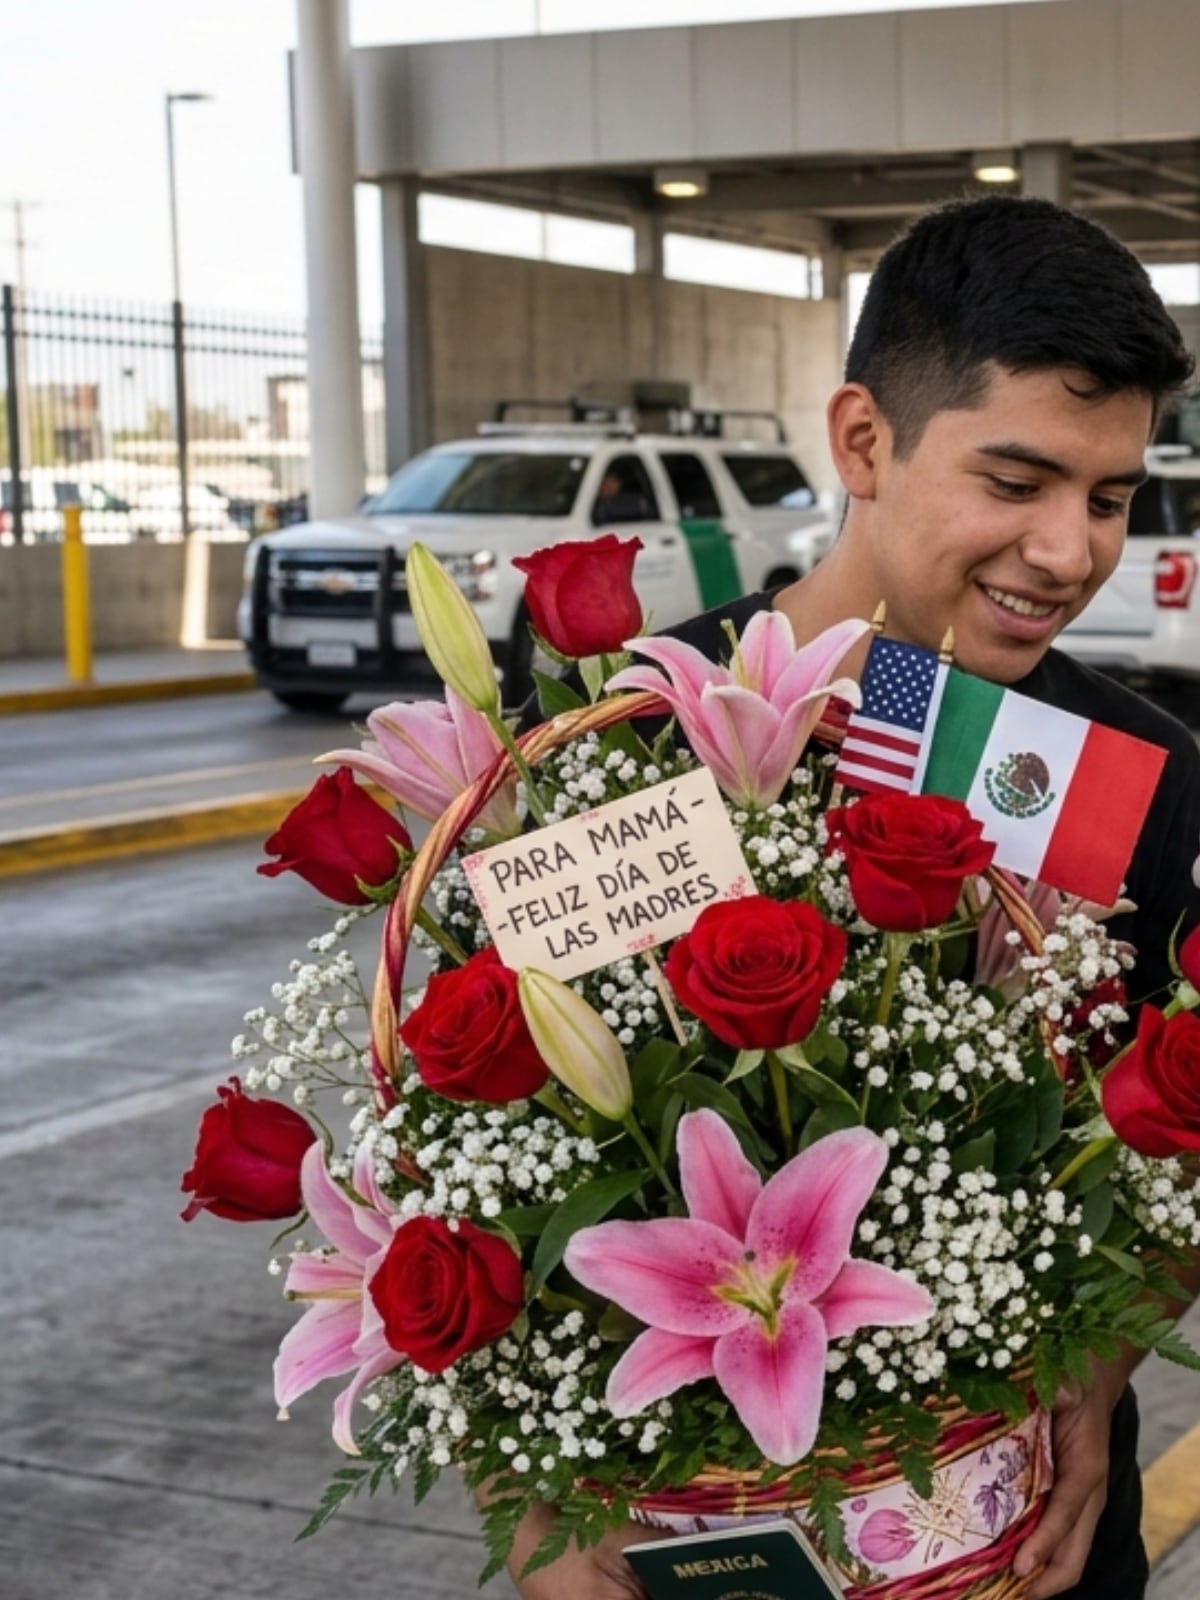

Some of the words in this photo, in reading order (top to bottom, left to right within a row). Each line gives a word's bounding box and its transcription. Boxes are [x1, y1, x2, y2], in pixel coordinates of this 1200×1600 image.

[489, 841, 577, 894] PARA
[596, 858, 650, 899] DÍA
[657, 841, 698, 876] DE
[545, 921, 598, 960] LAS
[606, 873, 718, 935] MADRES
